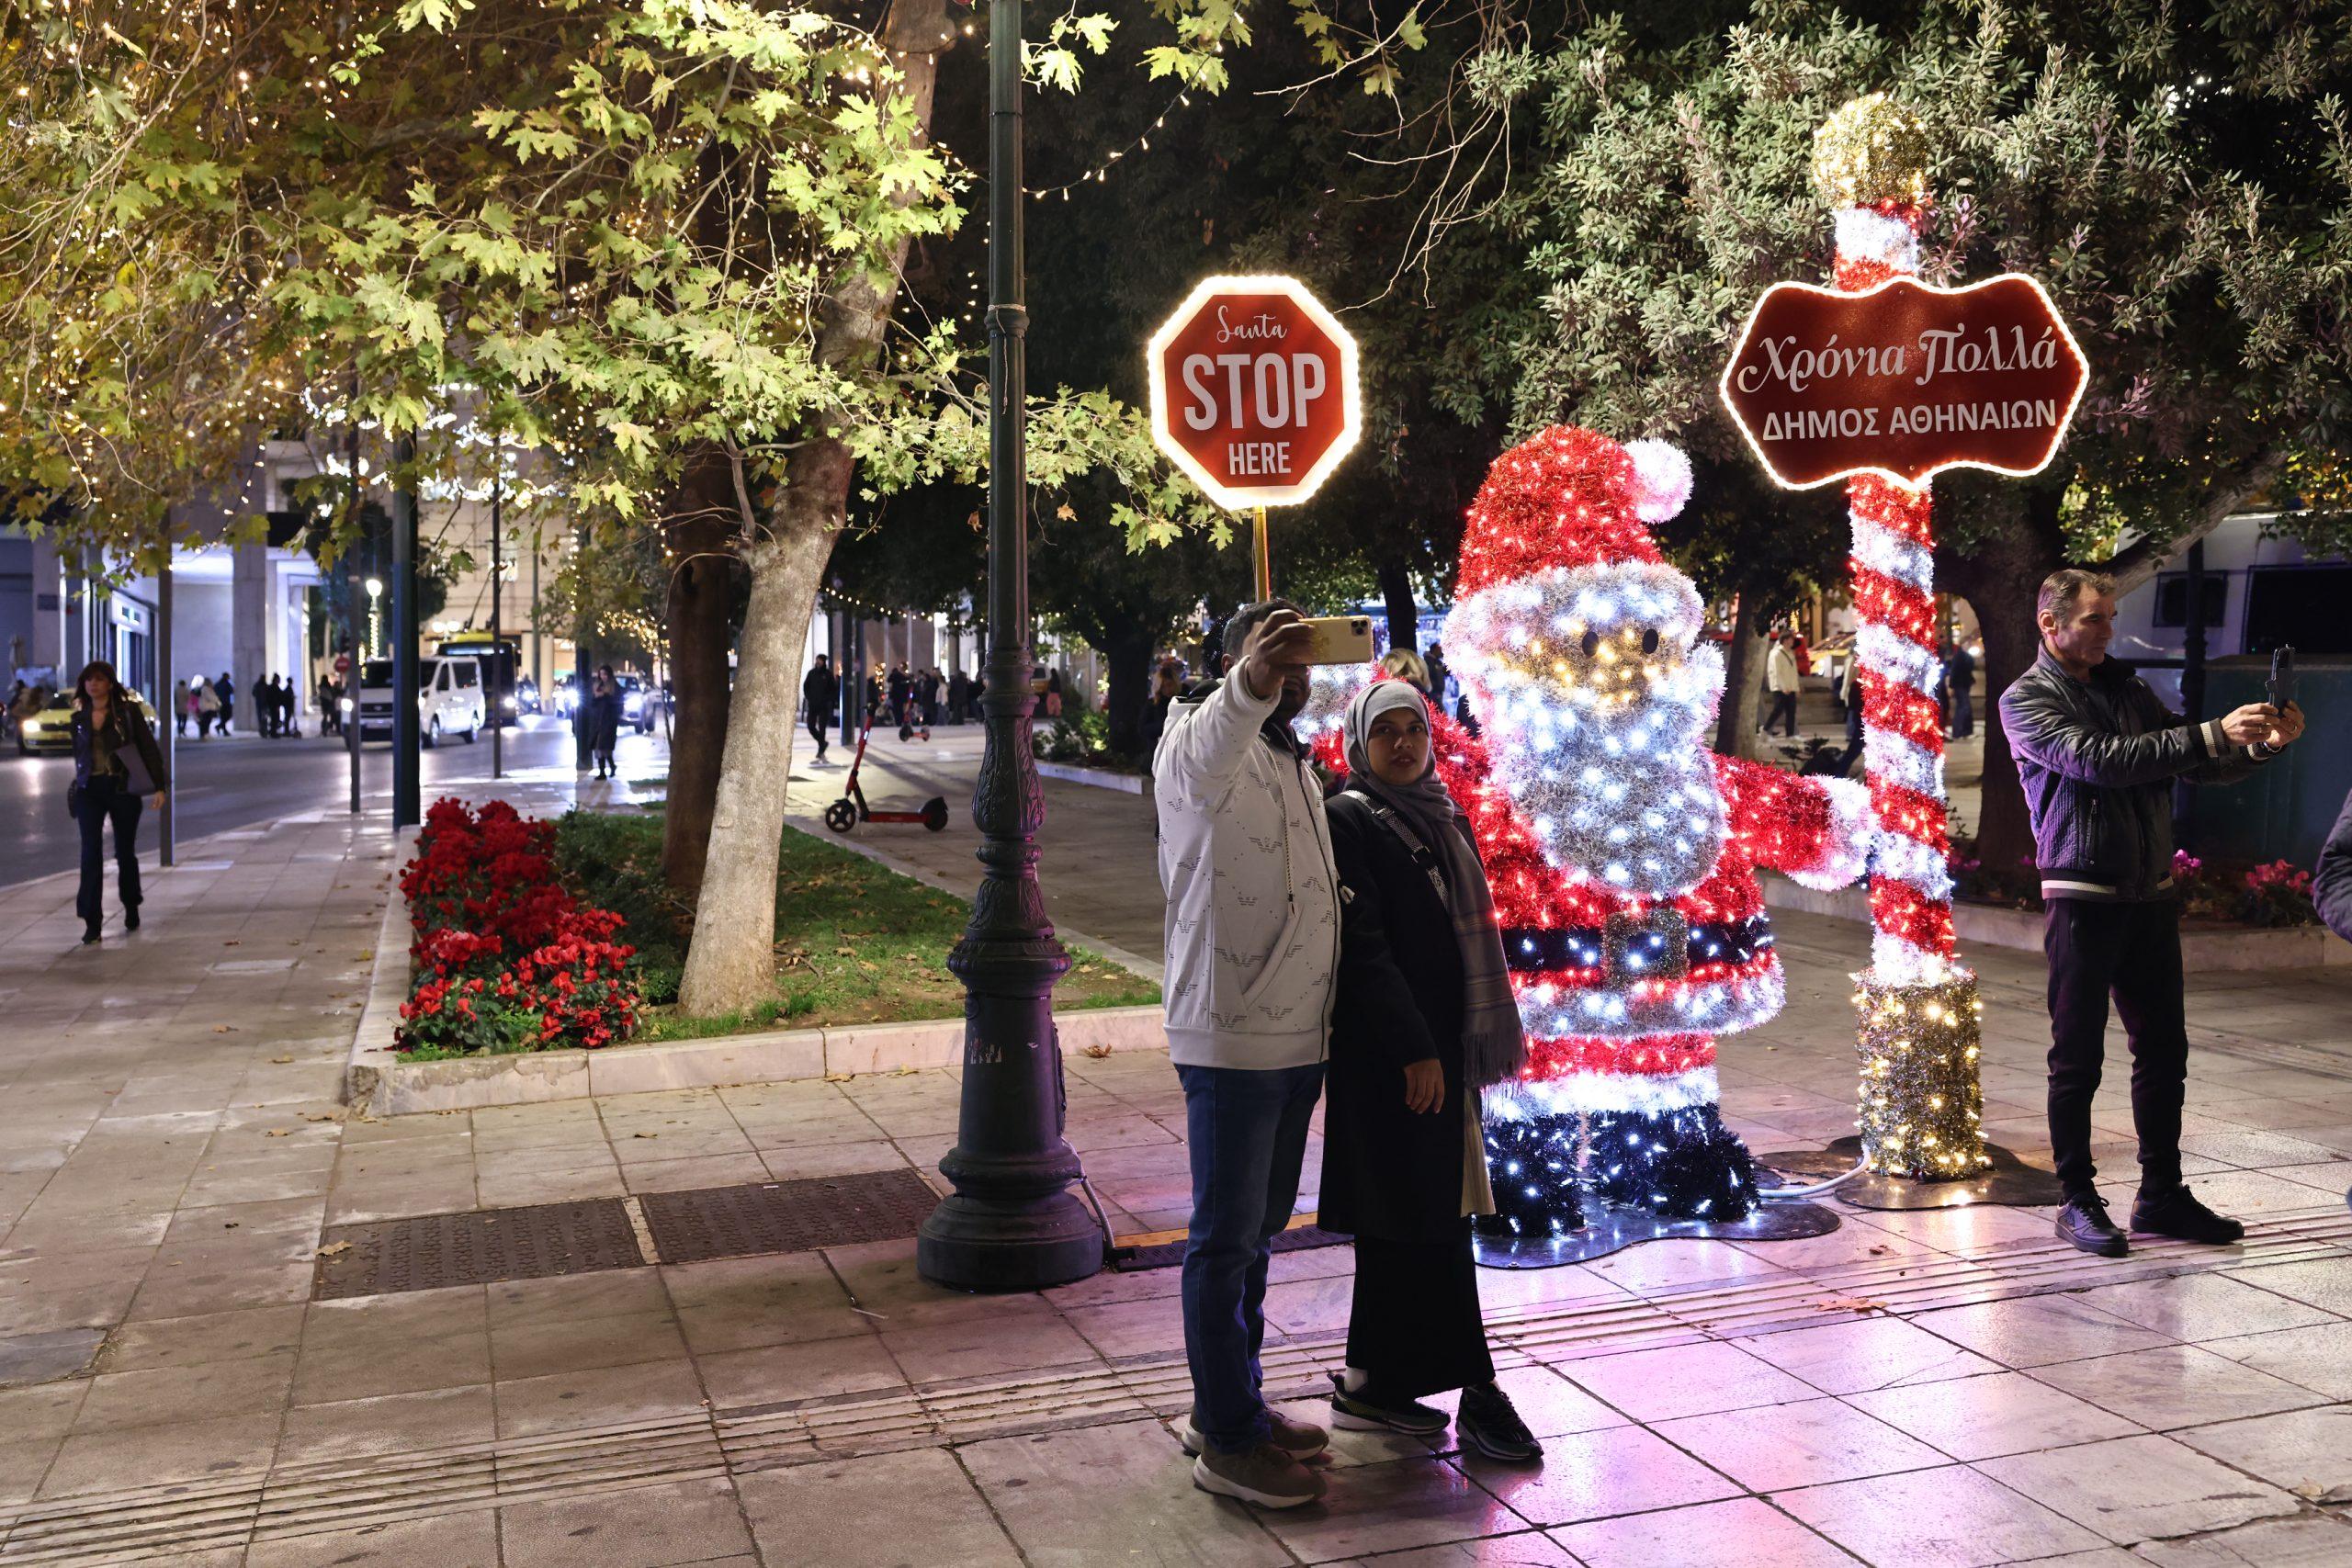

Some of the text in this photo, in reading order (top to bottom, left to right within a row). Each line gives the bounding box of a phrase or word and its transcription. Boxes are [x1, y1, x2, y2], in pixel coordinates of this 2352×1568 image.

[1216, 305, 1287, 343] Santa
[1737, 322, 2058, 393] Χρόνια Πολλά
[1182, 353, 1326, 431] STOP
[1762, 399, 2057, 441] ΔΗΜΟΣ ΑΘΗΝΑΙΩΝ
[1228, 441, 1292, 475] HERE
